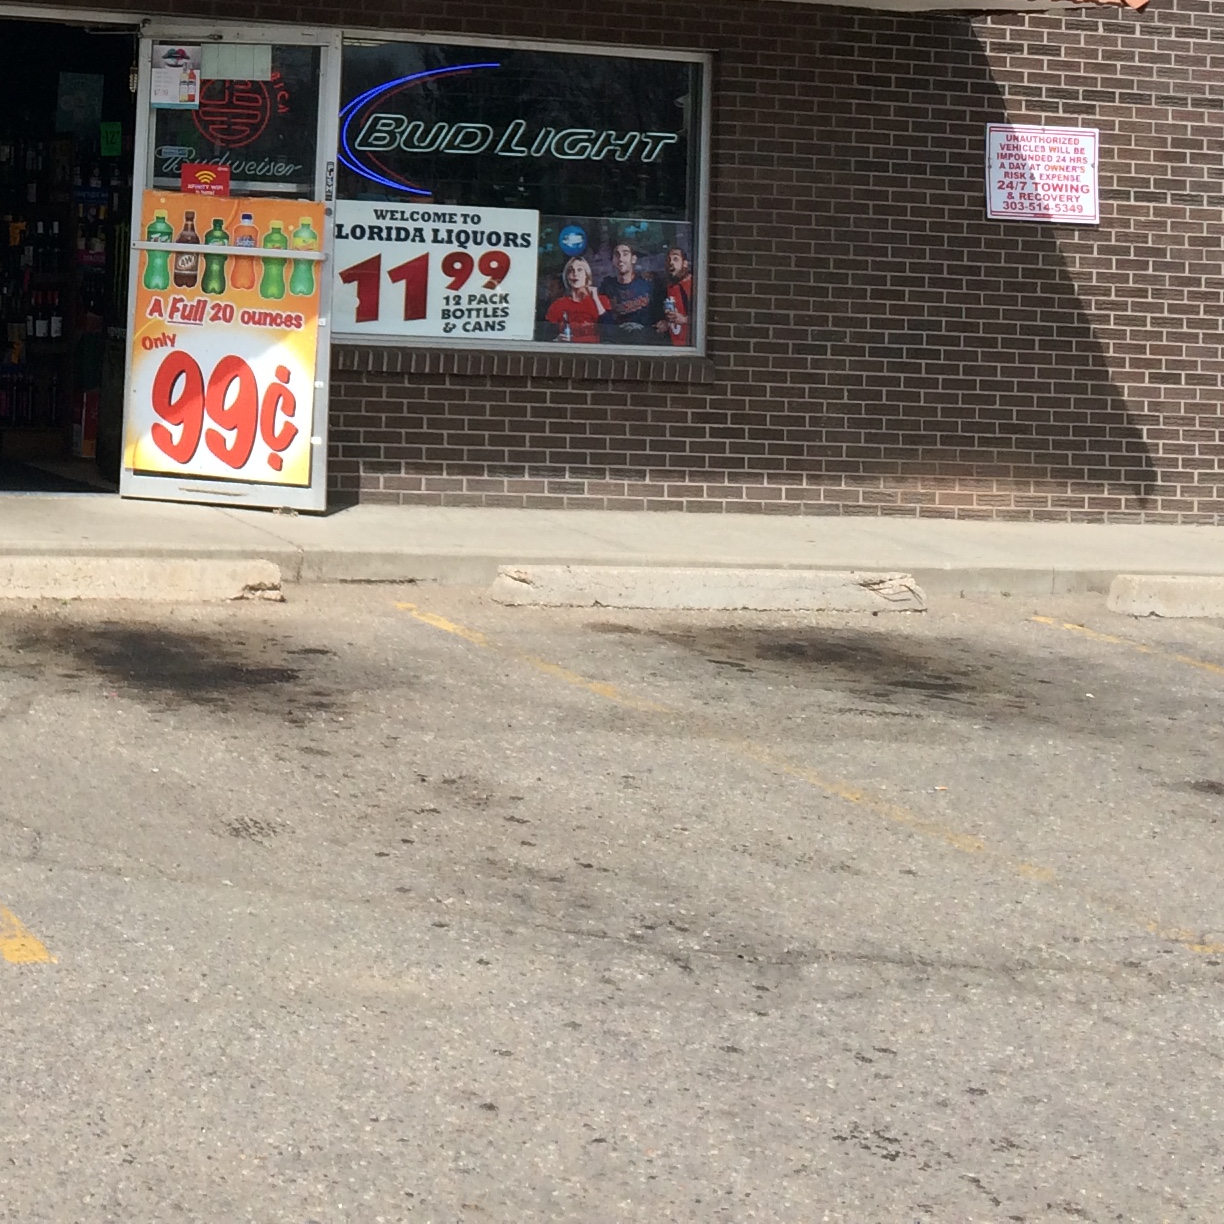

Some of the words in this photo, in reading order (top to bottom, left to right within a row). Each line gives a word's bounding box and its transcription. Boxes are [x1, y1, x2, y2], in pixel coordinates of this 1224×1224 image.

[354, 113, 493, 154] BUD
[494, 119, 678, 163] LIGHT
[1005, 134, 1080, 146] UNAUTHORIZED
[999, 143, 1046, 153] VEHICLES
[1048, 146, 1071, 155] WILL
[1073, 147, 1086, 155] BE
[996, 152, 1053, 163] IMPOUNDED
[1055, 155, 1067, 163] 24
[1069, 156, 1088, 165] HRS
[999, 162, 1006, 170] A
[1008, 162, 1027, 171] DAY
[1028, 163, 1041, 172] AT
[1043, 164, 1086, 174] OWNER'S
[1003, 171, 1027, 180] RISK
[1029, 172, 1036, 181] &
[1039, 173, 1081, 183] EXPENSE
[996, 180, 1028, 192] 24/7
[1031, 181, 1090, 194] TOWING
[1006, 191, 1015, 200] &
[1018, 192, 1081, 203] RECOVERY
[1002, 201, 1084, 214] 303-514-5349
[373, 208, 457, 224] WELCOME
[460, 213, 481, 225] TO
[335, 223, 426, 243] LORIDA
[431, 228, 532, 250] LIQUORS
[442, 294, 462, 306] 12
[467, 292, 510, 305] PACK
[148, 297, 164, 318] A
[168, 296, 208, 323] Full
[208, 302, 234, 323] 20
[240, 309, 303, 329] ounces
[441, 306, 510, 320] BOTTLES
[442, 322, 457, 334] &
[462, 320, 506, 333] CANS
[141, 332, 177, 351] Only
[151, 349, 299, 472] 99¢
